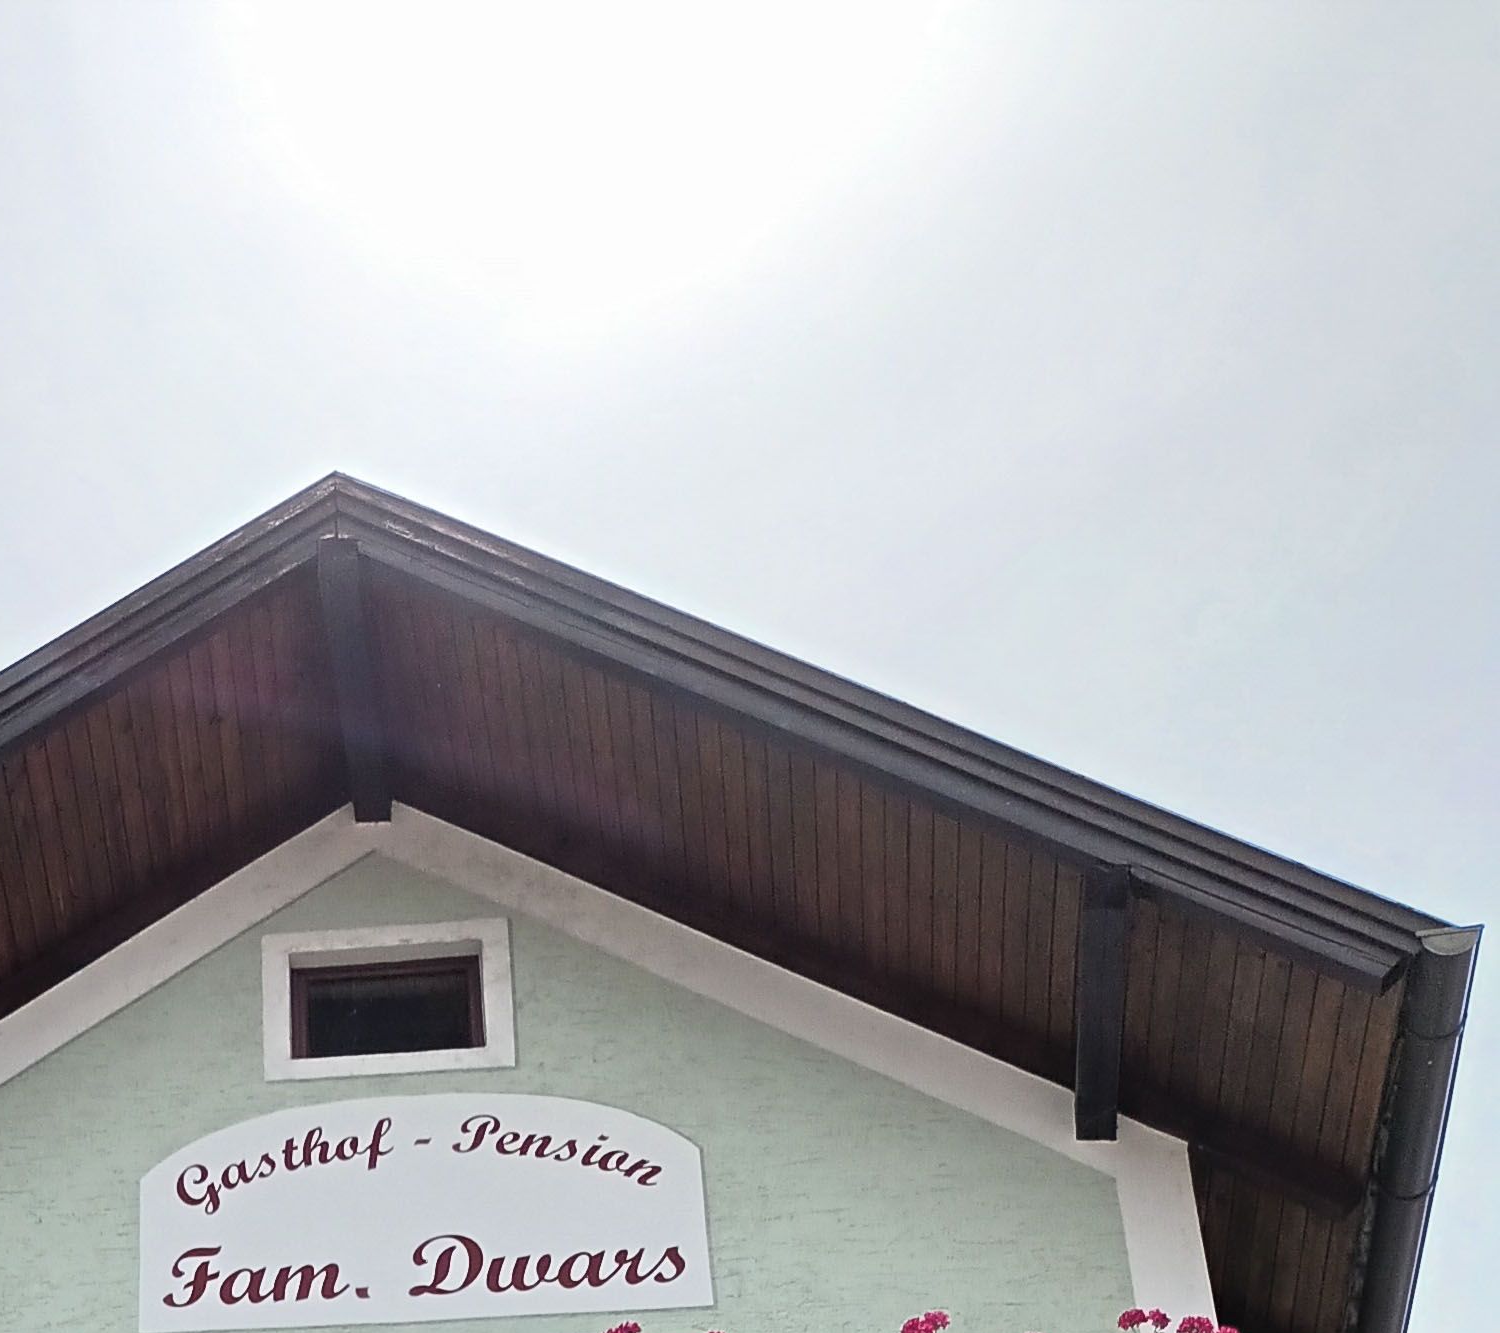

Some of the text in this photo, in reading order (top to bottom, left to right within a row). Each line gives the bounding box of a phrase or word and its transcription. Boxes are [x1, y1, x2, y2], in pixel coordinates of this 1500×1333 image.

[176, 1117, 395, 1215] Gasthof
[452, 1114, 663, 1186] Pension
[162, 1234, 687, 1308] Fam. Dwars
